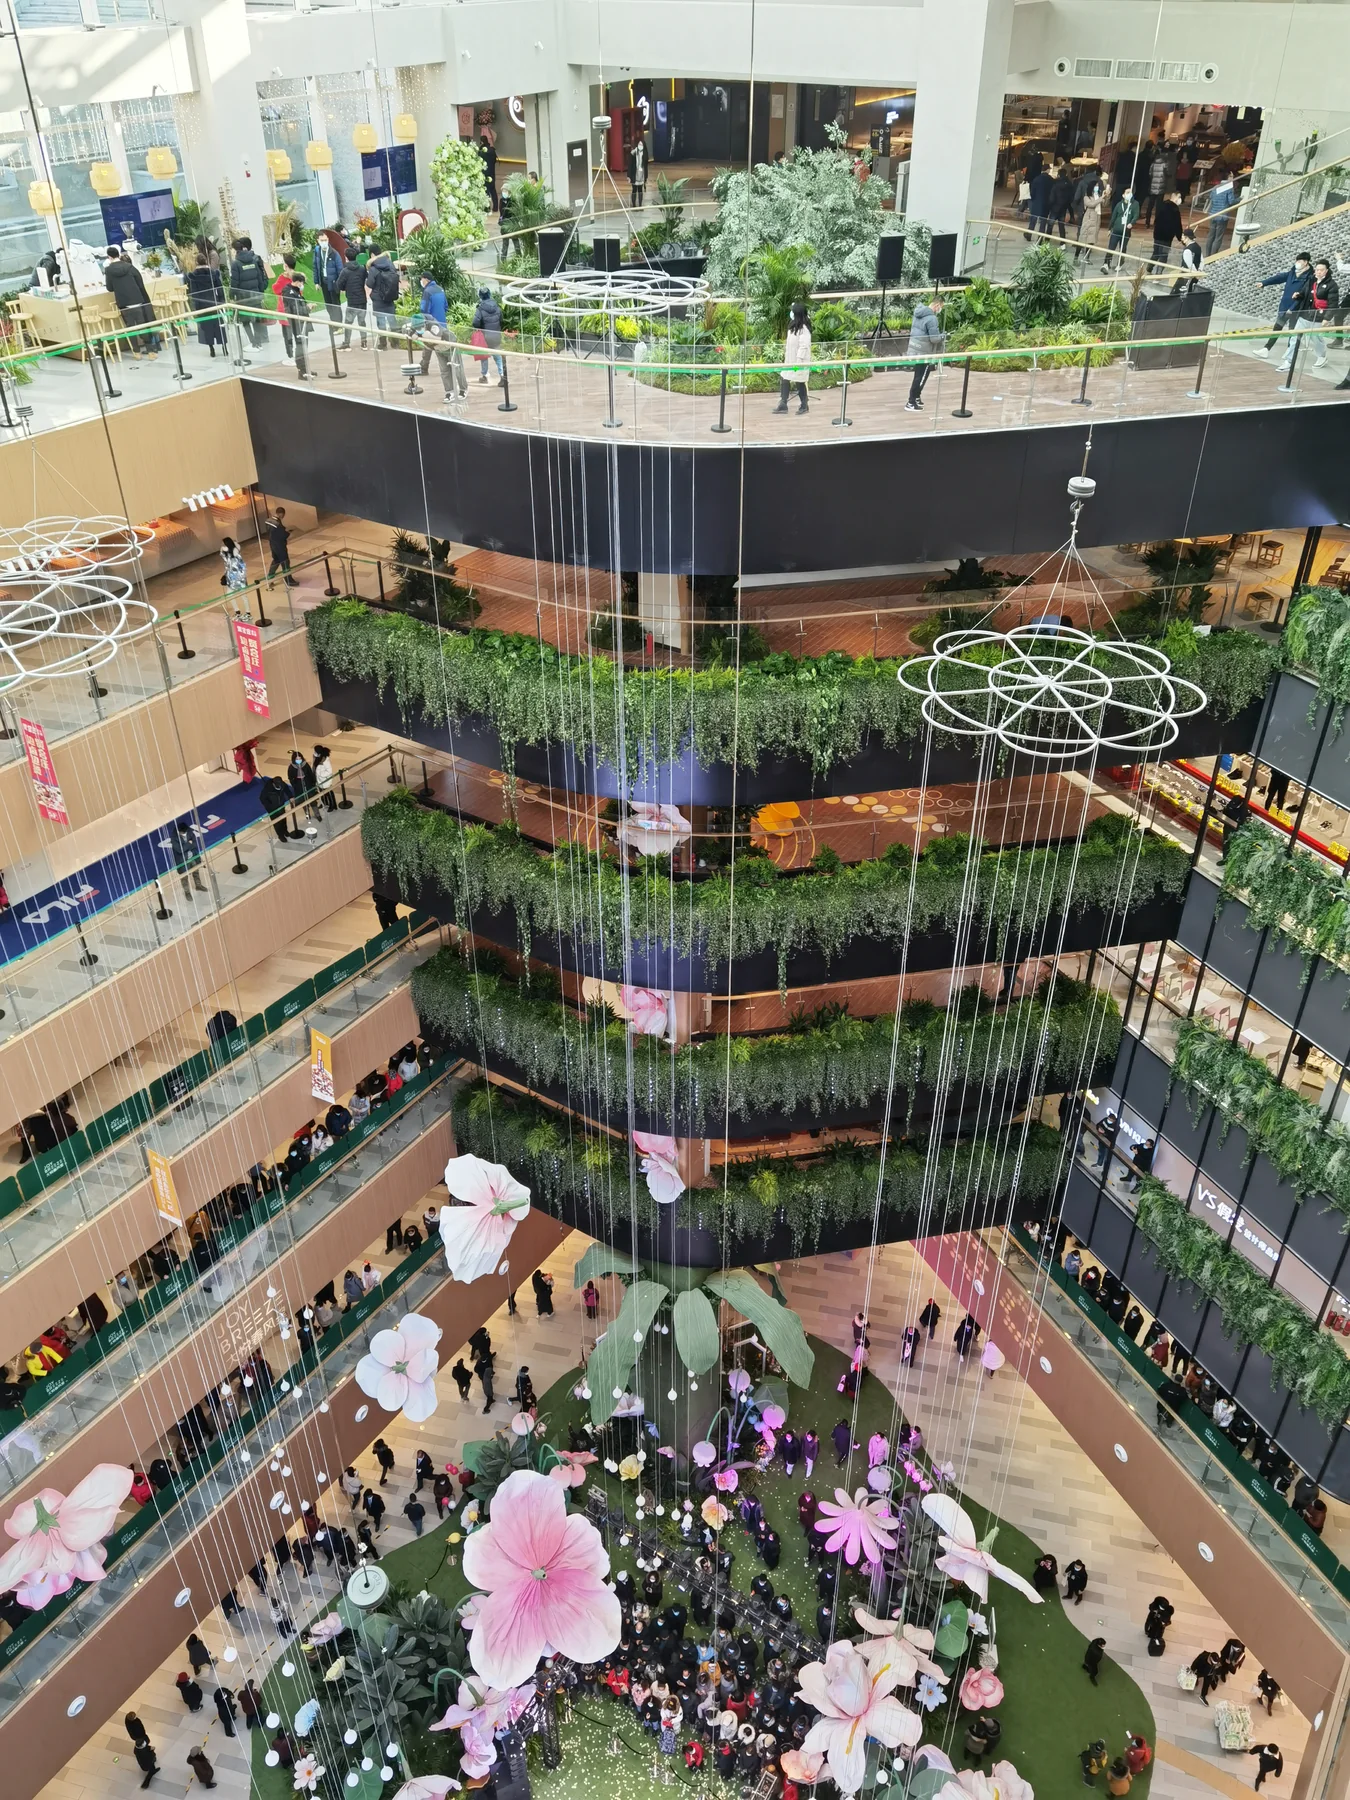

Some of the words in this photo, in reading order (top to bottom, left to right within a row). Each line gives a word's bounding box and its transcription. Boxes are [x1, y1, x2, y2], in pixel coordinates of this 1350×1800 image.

[158, 814, 226, 848] FIA
[22, 884, 100, 924] FILA
[217, 1299, 248, 1339] JOY
[220, 1289, 284, 1355] BREEZE
